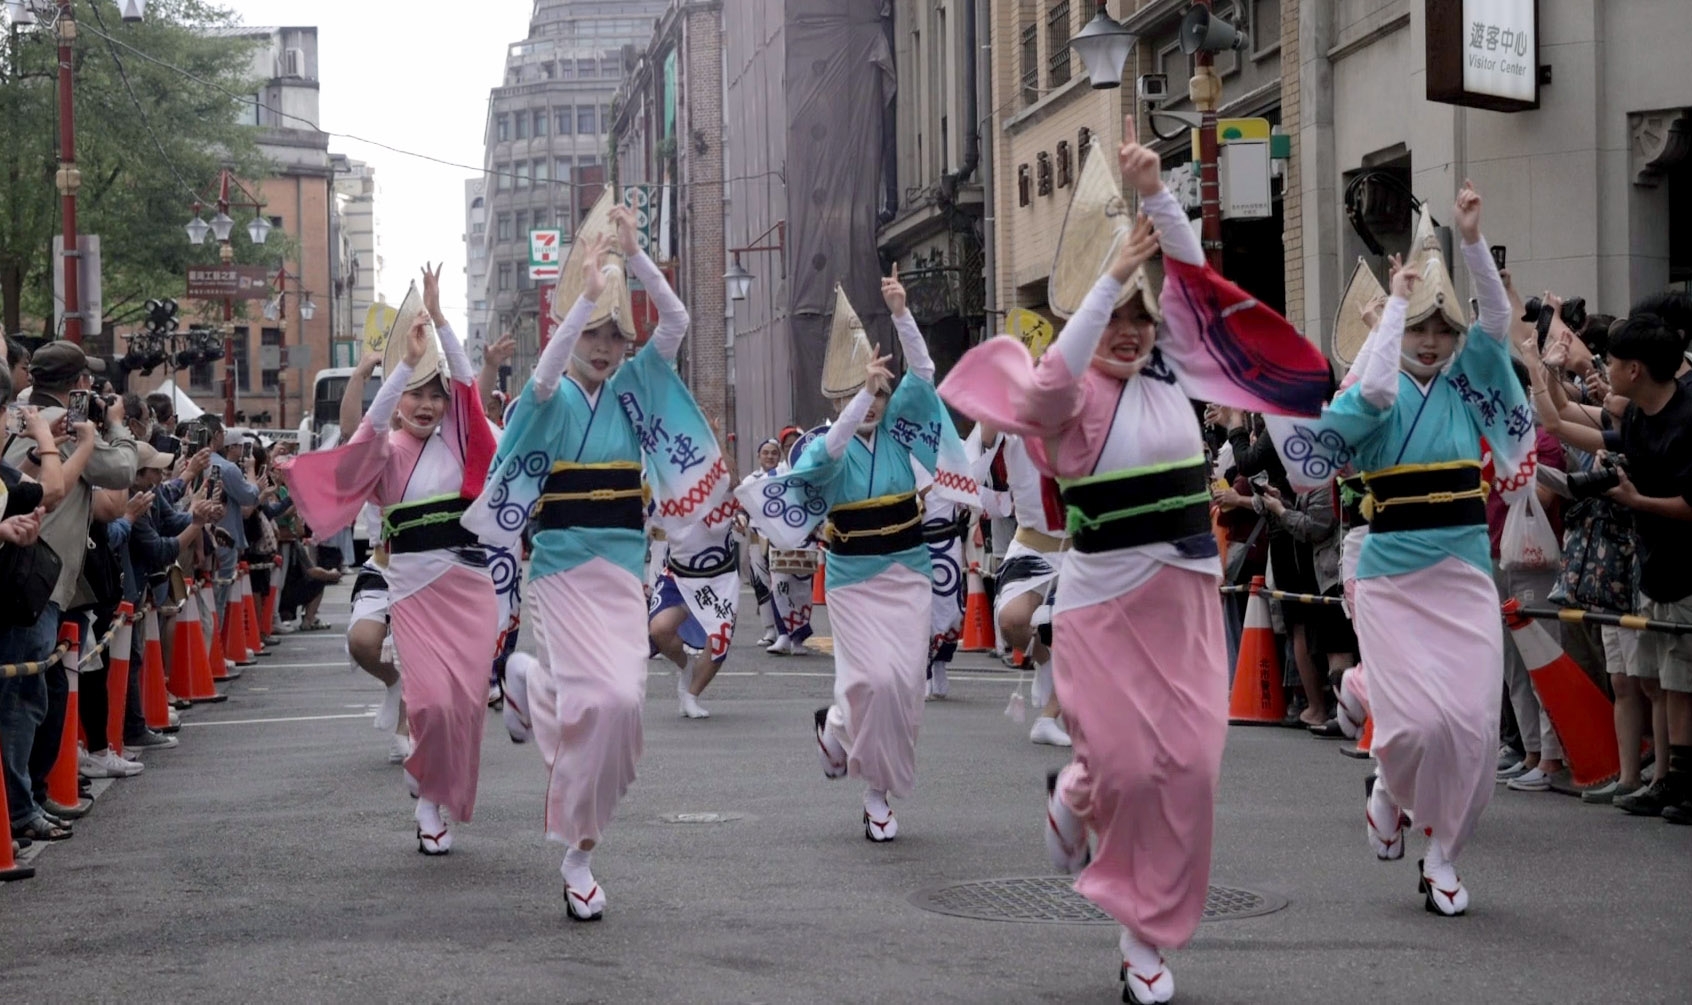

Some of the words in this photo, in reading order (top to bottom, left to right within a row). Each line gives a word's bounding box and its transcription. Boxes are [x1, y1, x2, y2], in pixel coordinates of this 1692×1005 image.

[1469, 22, 1528, 57] 遊客中心
[1469, 54, 1496, 71] Visitor
[1501, 59, 1527, 76] Center
[536, 234, 556, 261] 7
